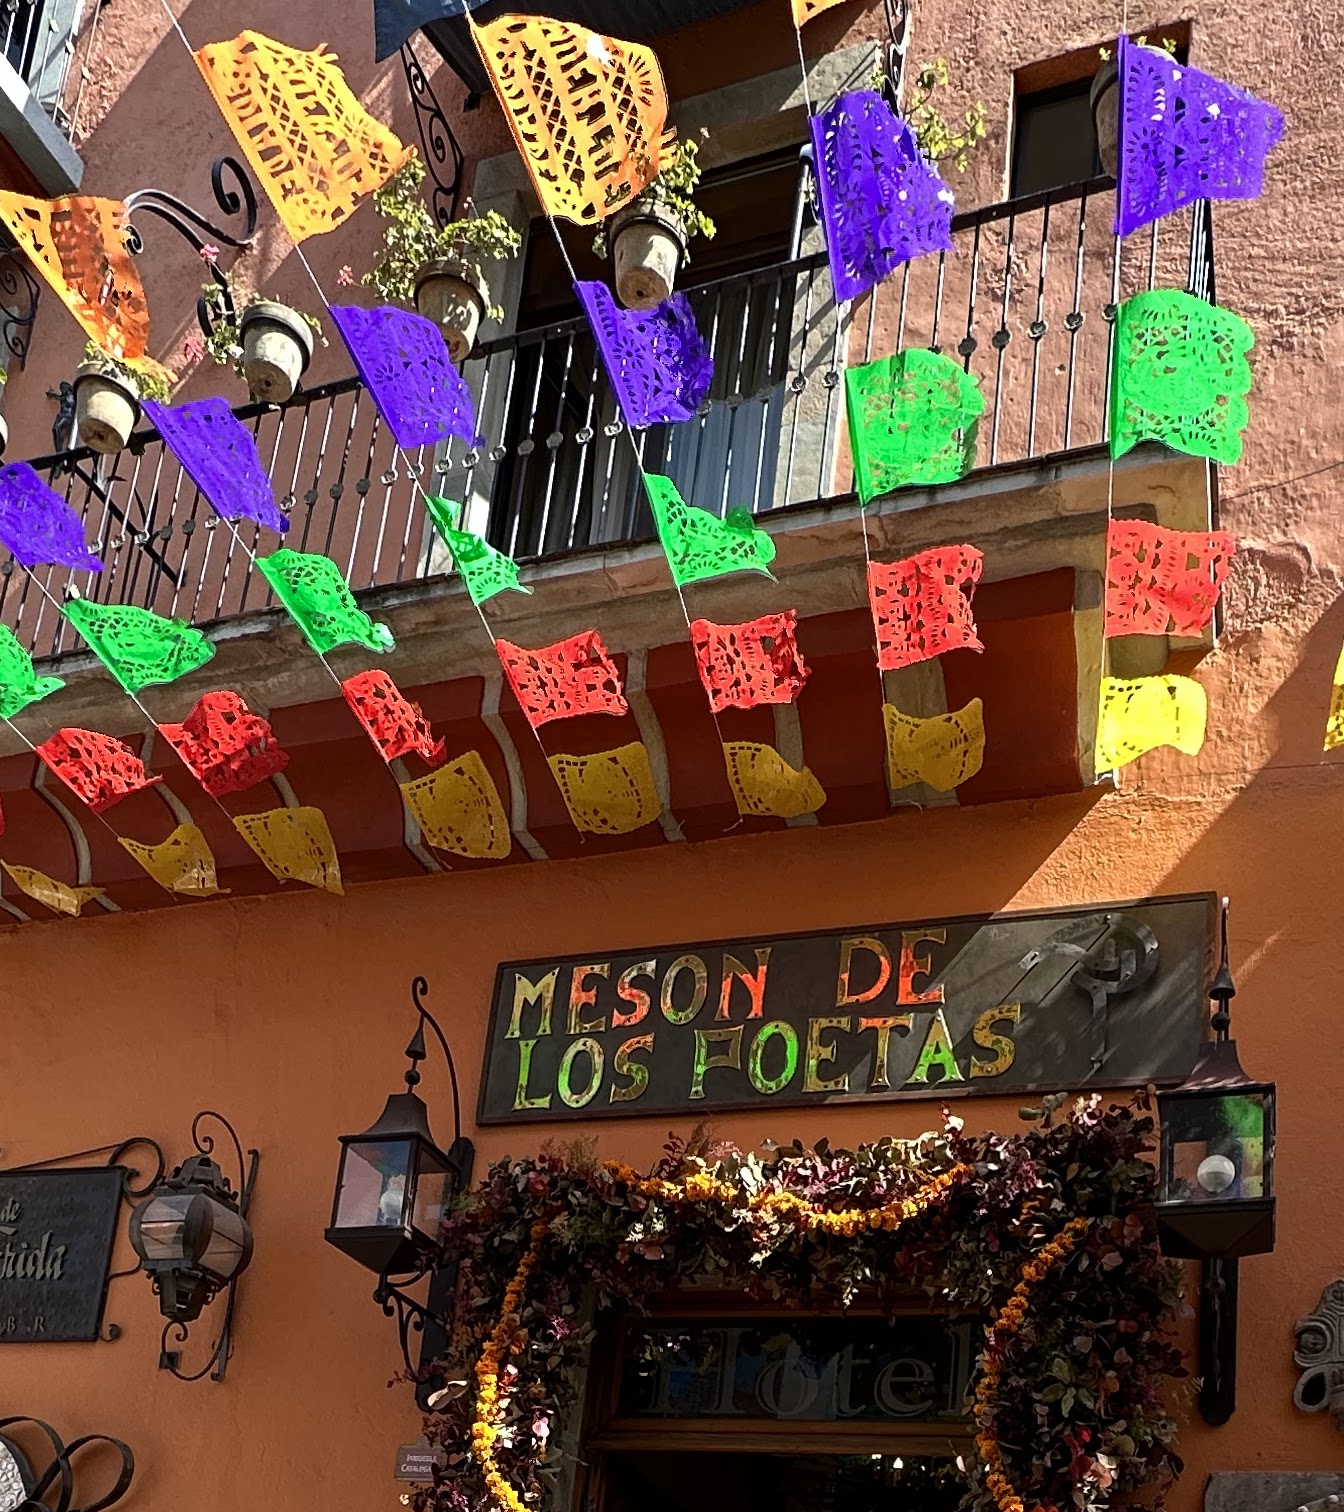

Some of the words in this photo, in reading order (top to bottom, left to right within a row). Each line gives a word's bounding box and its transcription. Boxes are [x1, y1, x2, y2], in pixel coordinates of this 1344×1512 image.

[505, 947, 772, 1038] MESON
[835, 929, 947, 1006] DE
[512, 1032, 654, 1111] LOS
[689, 1004, 1020, 1099] POETAS
[0, 1196, 21, 1222] de
[6, 1315, 47, 1334] BR
[636, 1323, 972, 1419] Hotel
